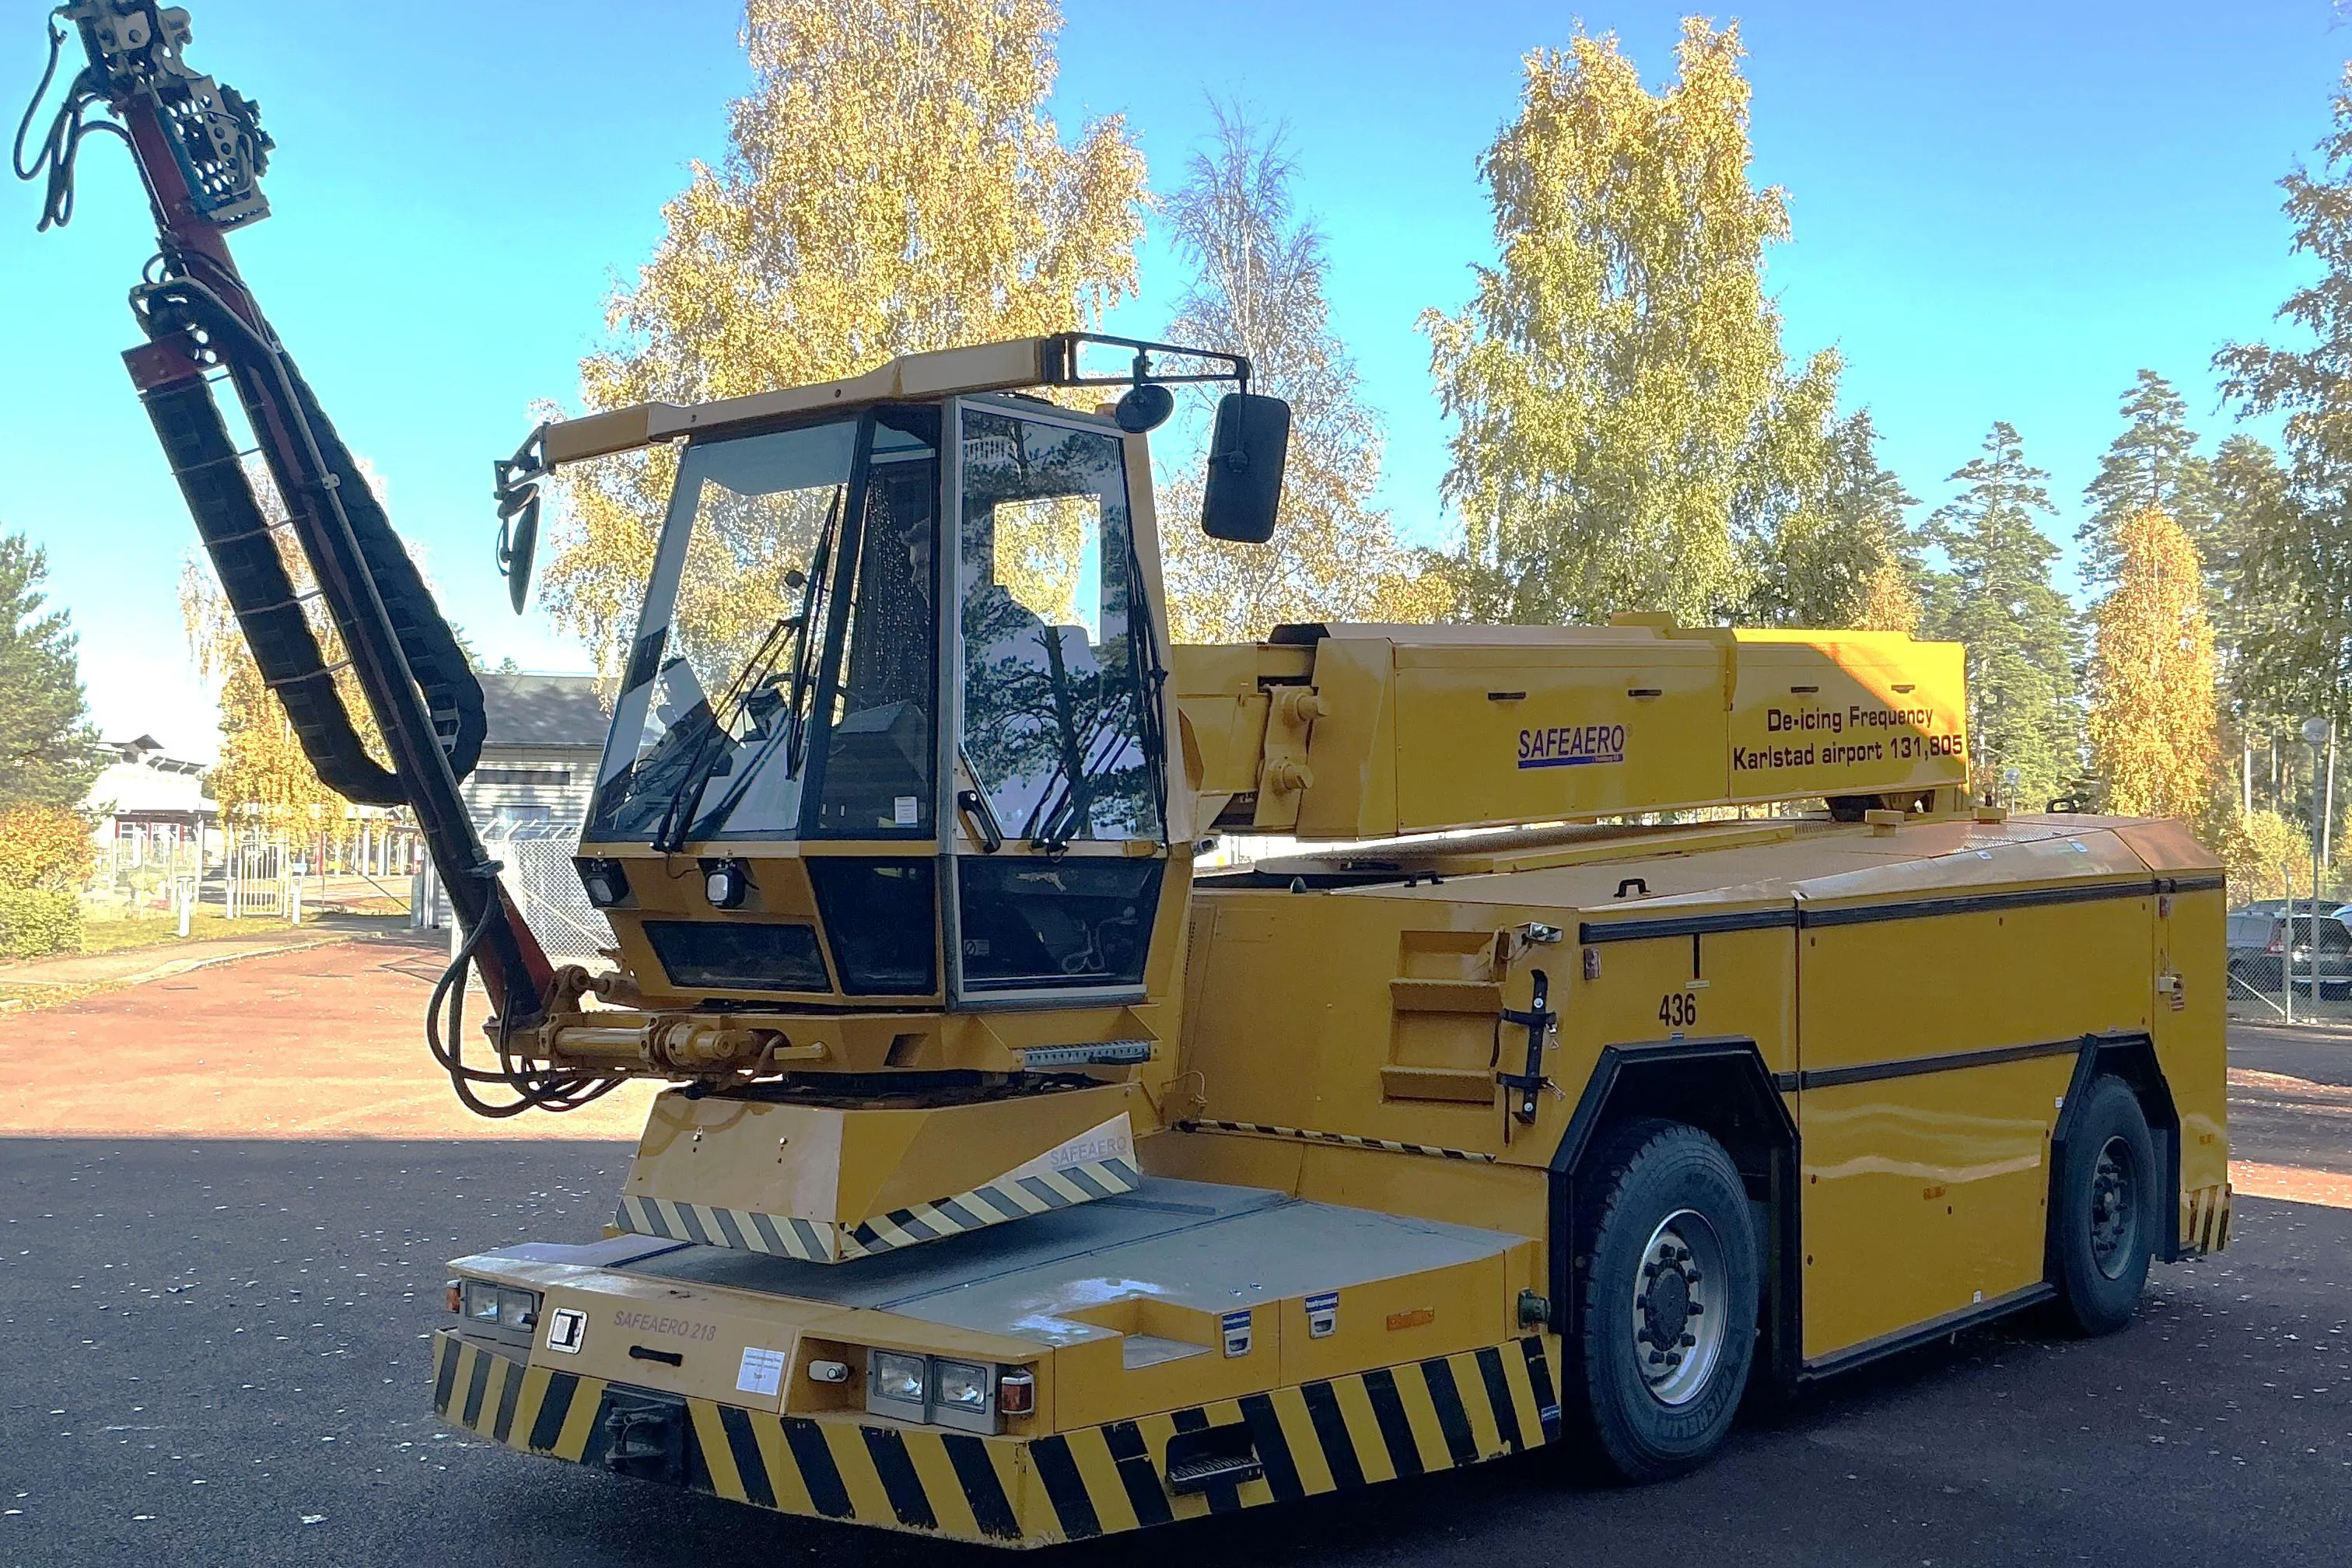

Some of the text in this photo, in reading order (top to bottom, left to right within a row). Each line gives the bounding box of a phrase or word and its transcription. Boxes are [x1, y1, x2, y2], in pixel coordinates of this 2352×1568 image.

[1767, 706, 1933, 733] De-icing Frequency
[1518, 725, 1624, 758] SAFEAERO
[1734, 734, 1962, 770] Karlstad airport 131,805
[1659, 993, 1696, 1027] 436
[1051, 1137, 1126, 1165] SAFEAERO
[614, 1311, 689, 1336] SAFEAERO
